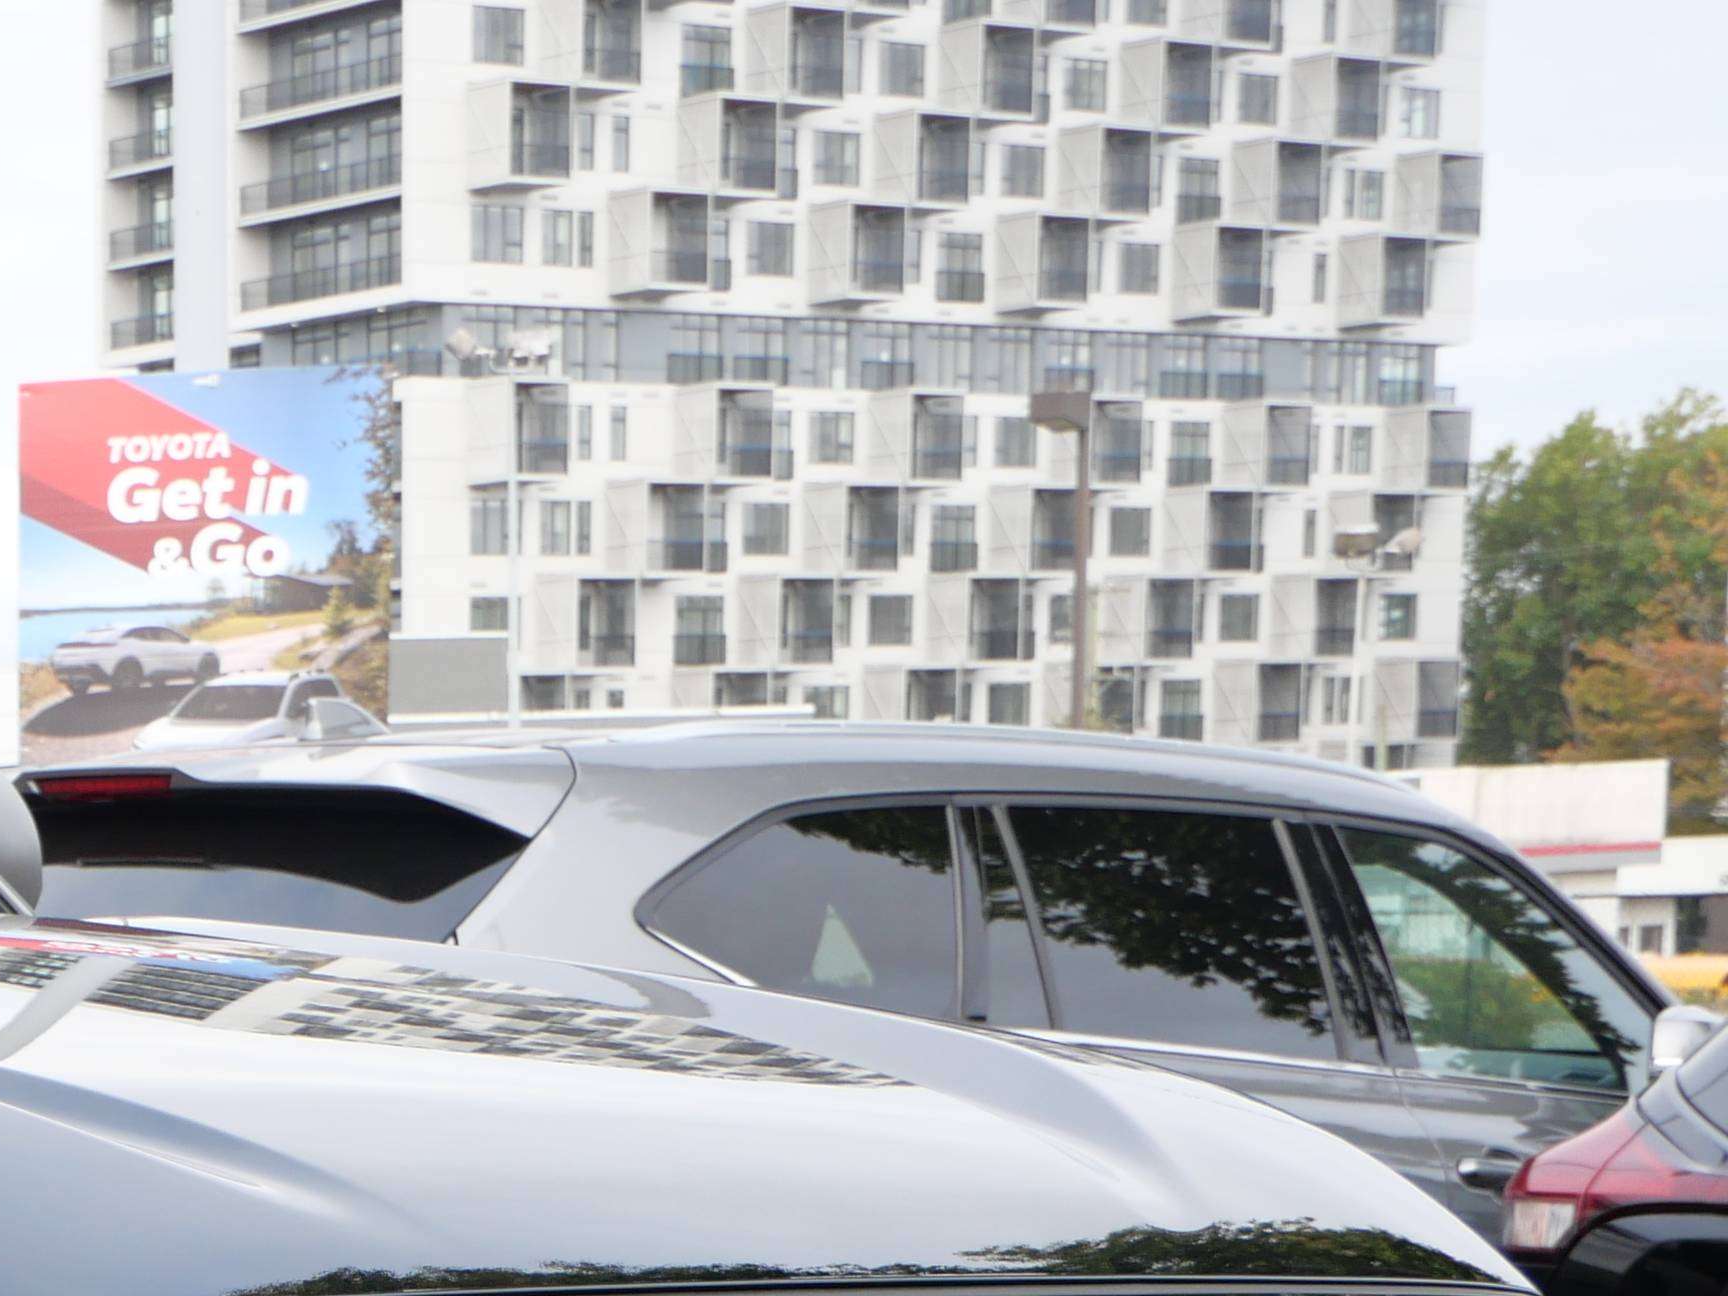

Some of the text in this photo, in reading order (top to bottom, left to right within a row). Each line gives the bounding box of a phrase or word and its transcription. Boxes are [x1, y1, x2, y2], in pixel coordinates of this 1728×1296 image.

[107, 432, 231, 464] TOYOTA
[107, 458, 309, 523] Get in
